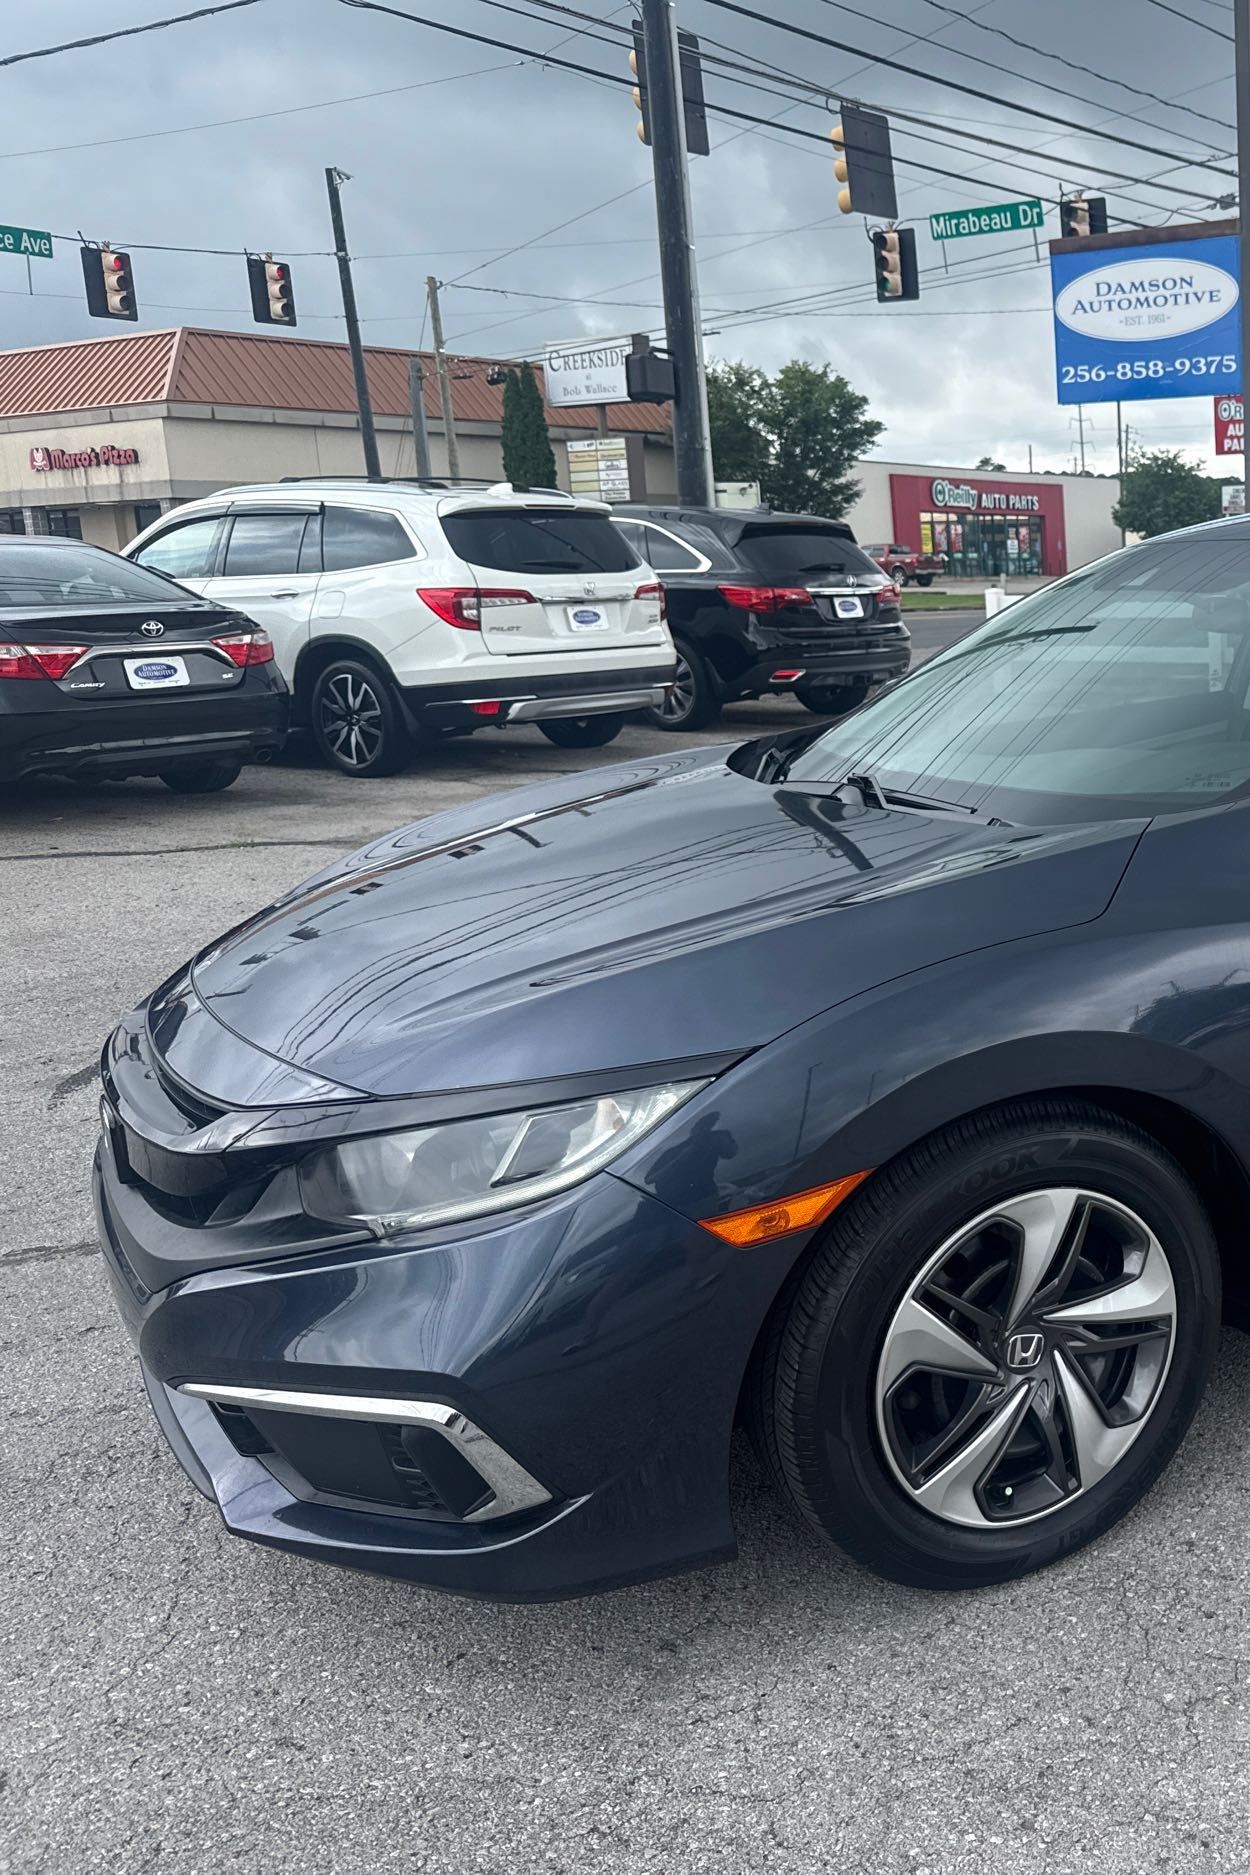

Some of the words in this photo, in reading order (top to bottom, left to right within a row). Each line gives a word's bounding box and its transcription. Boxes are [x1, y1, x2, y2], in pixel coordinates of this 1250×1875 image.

[931, 212, 1012, 238] Mirabeau
[1018, 204, 1040, 227] Dr
[20, 231, 50, 255] Ave
[1095, 275, 1194, 298] DAMSON
[1071, 289, 1222, 315] AUTOMOTIVE
[1062, 354, 1238, 384] 256-858-9375
[50, 447, 98, 470] Marco's
[99, 445, 135, 465] Pizza
[932, 479, 978, 510] O'Reilly
[981, 493, 1007, 509] AUTO
[1009, 494, 1039, 511] PARTS
